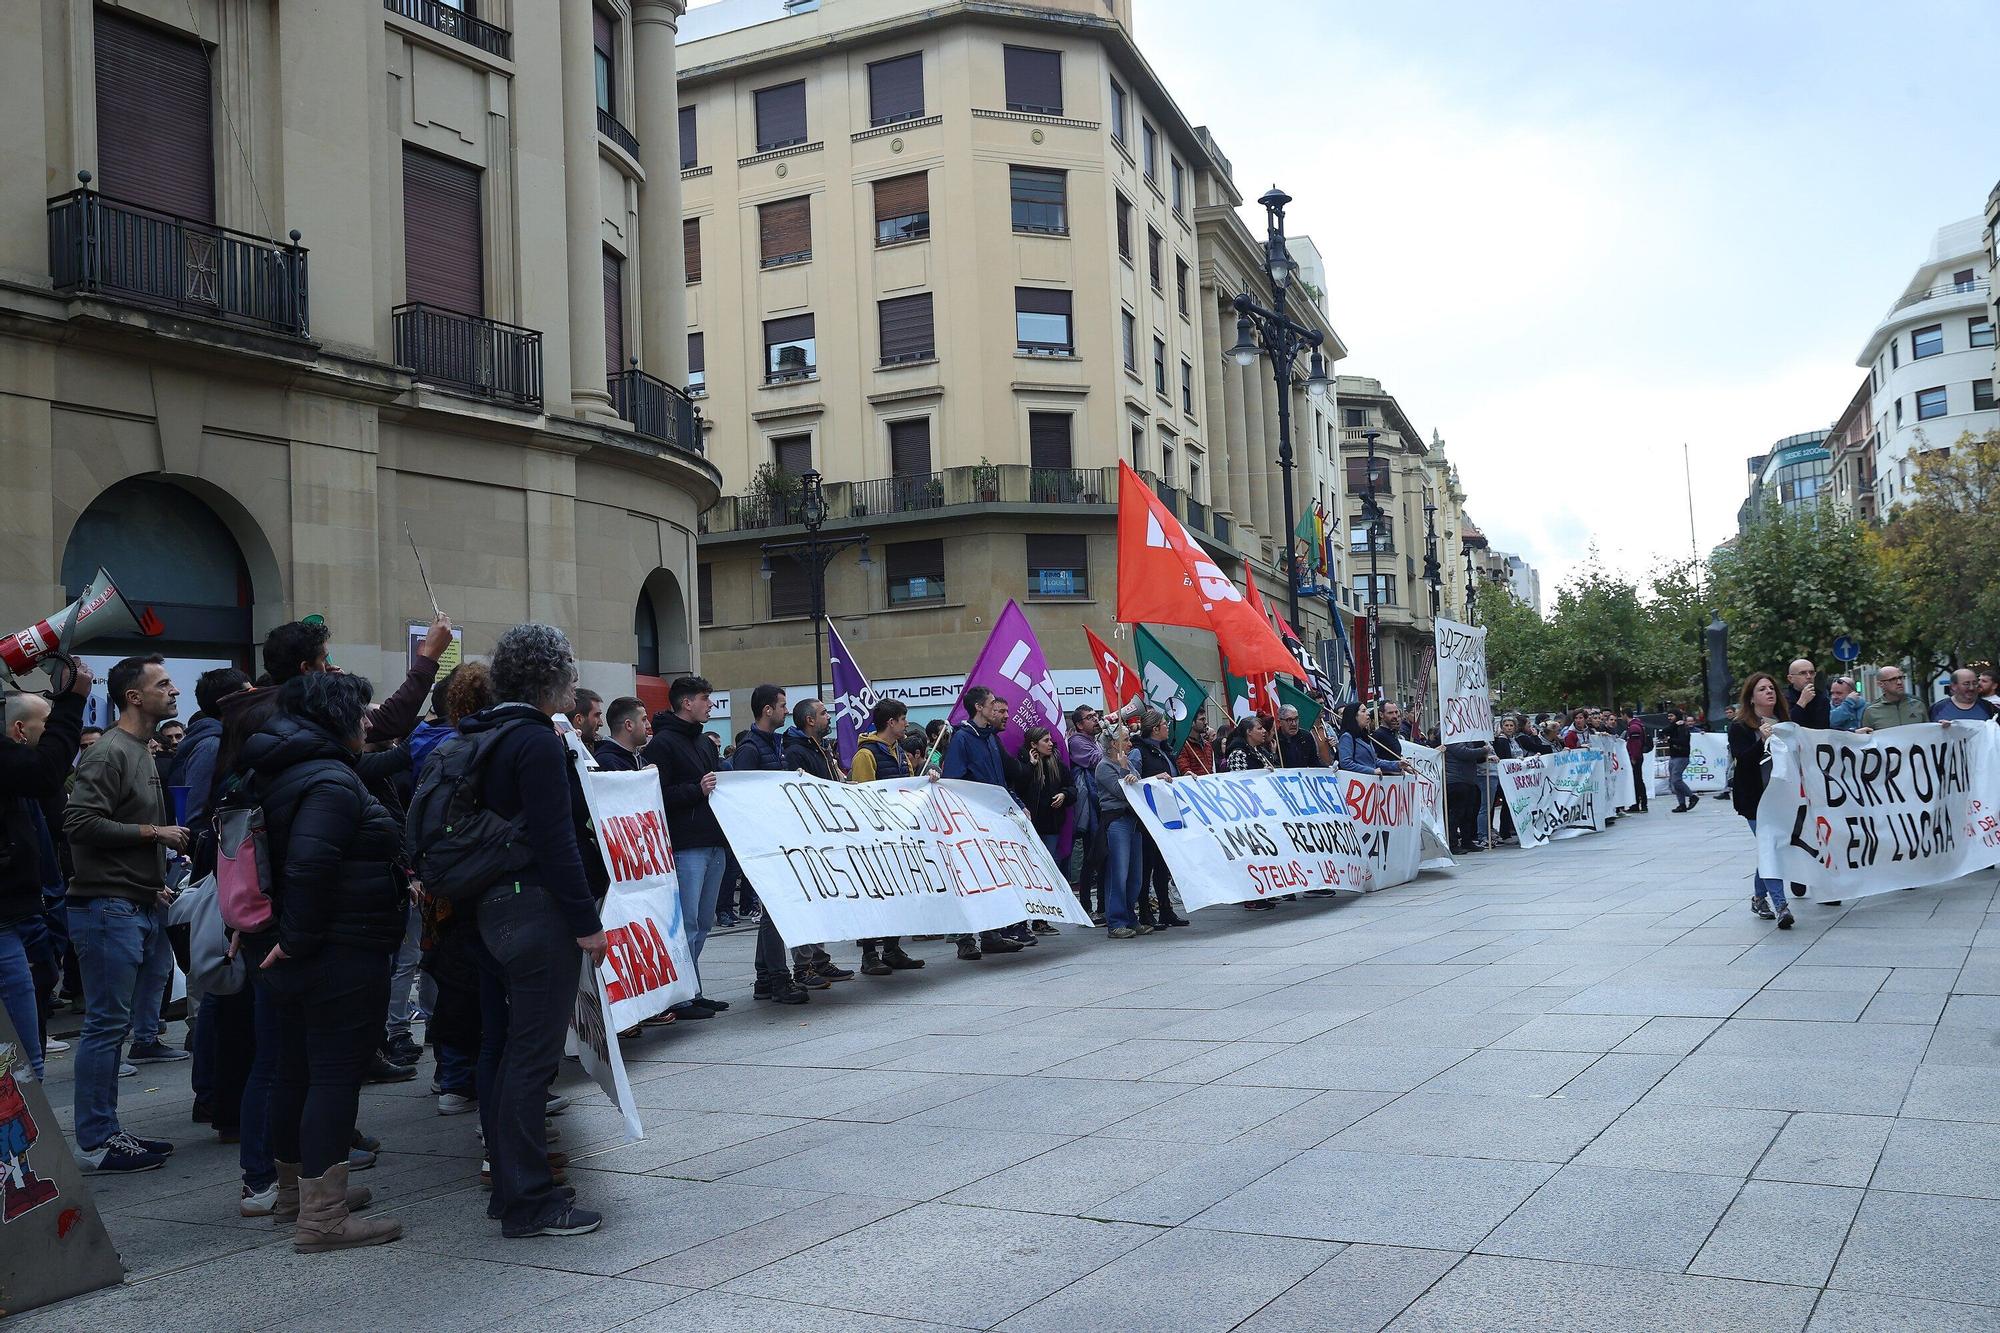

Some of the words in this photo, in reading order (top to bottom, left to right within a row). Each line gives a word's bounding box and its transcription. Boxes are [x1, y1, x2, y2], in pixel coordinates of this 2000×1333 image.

[874, 685, 963, 699] VITALDENT
[1057, 686, 1101, 695] LDENT
[1845, 816, 1879, 869] EN
[1887, 805, 1956, 862] LUCHA
[1247, 860, 1309, 895] STEILAS
[1317, 859, 1340, 886] LAB
